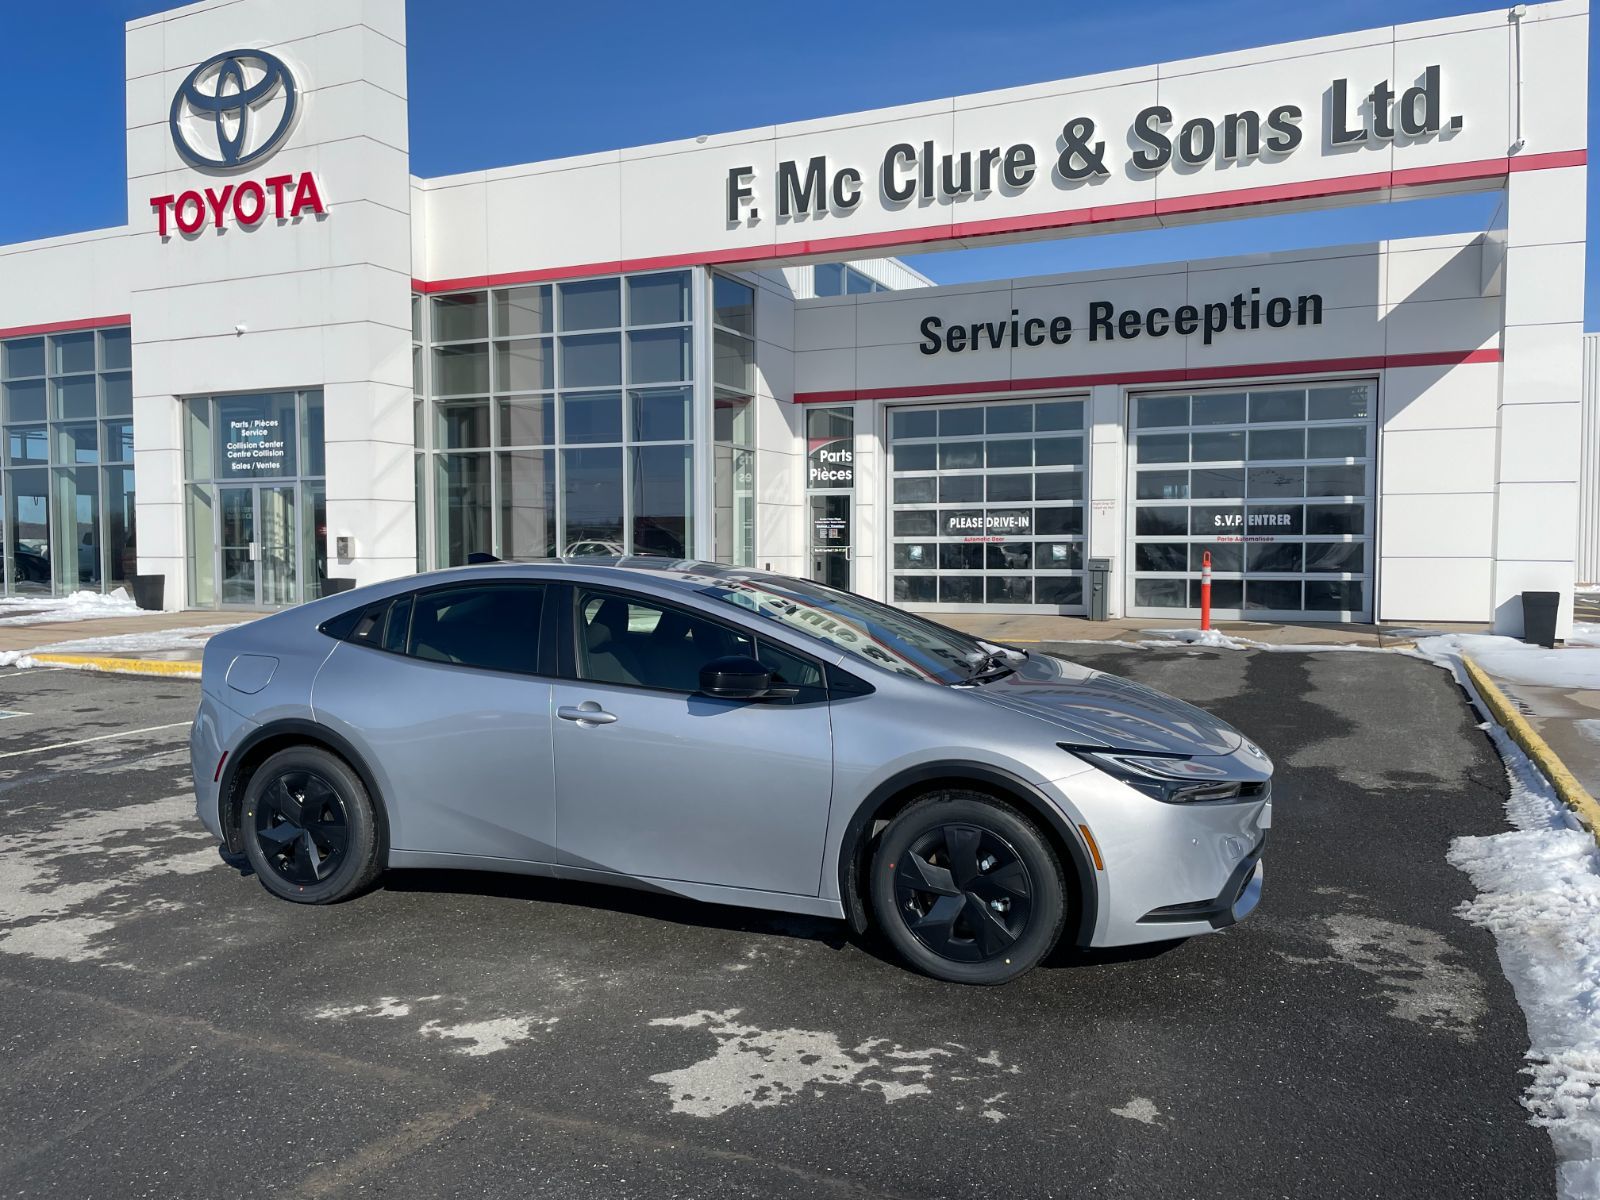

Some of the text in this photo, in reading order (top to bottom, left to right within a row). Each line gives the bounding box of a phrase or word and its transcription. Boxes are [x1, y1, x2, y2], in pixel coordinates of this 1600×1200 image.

[728, 64, 1463, 222] F. Mc Clure & Sons Ltd.
[150, 171, 324, 236] TOYOTA
[919, 286, 1323, 355] Service Reception
[231, 420, 249, 428] Parts
[254, 419, 279, 427] Pièces
[241, 428, 268, 436] Service
[227, 449, 284, 458] Centre Collision
[820, 449, 852, 463] Parts
[231, 462, 251, 470] Sales
[256, 461, 280, 469] Ventes
[809, 466, 852, 481] Pièces
[950, 516, 1029, 528] PLEASE DRIVE-IN
[1214, 514, 1291, 526] S.V.P. ENTRER
